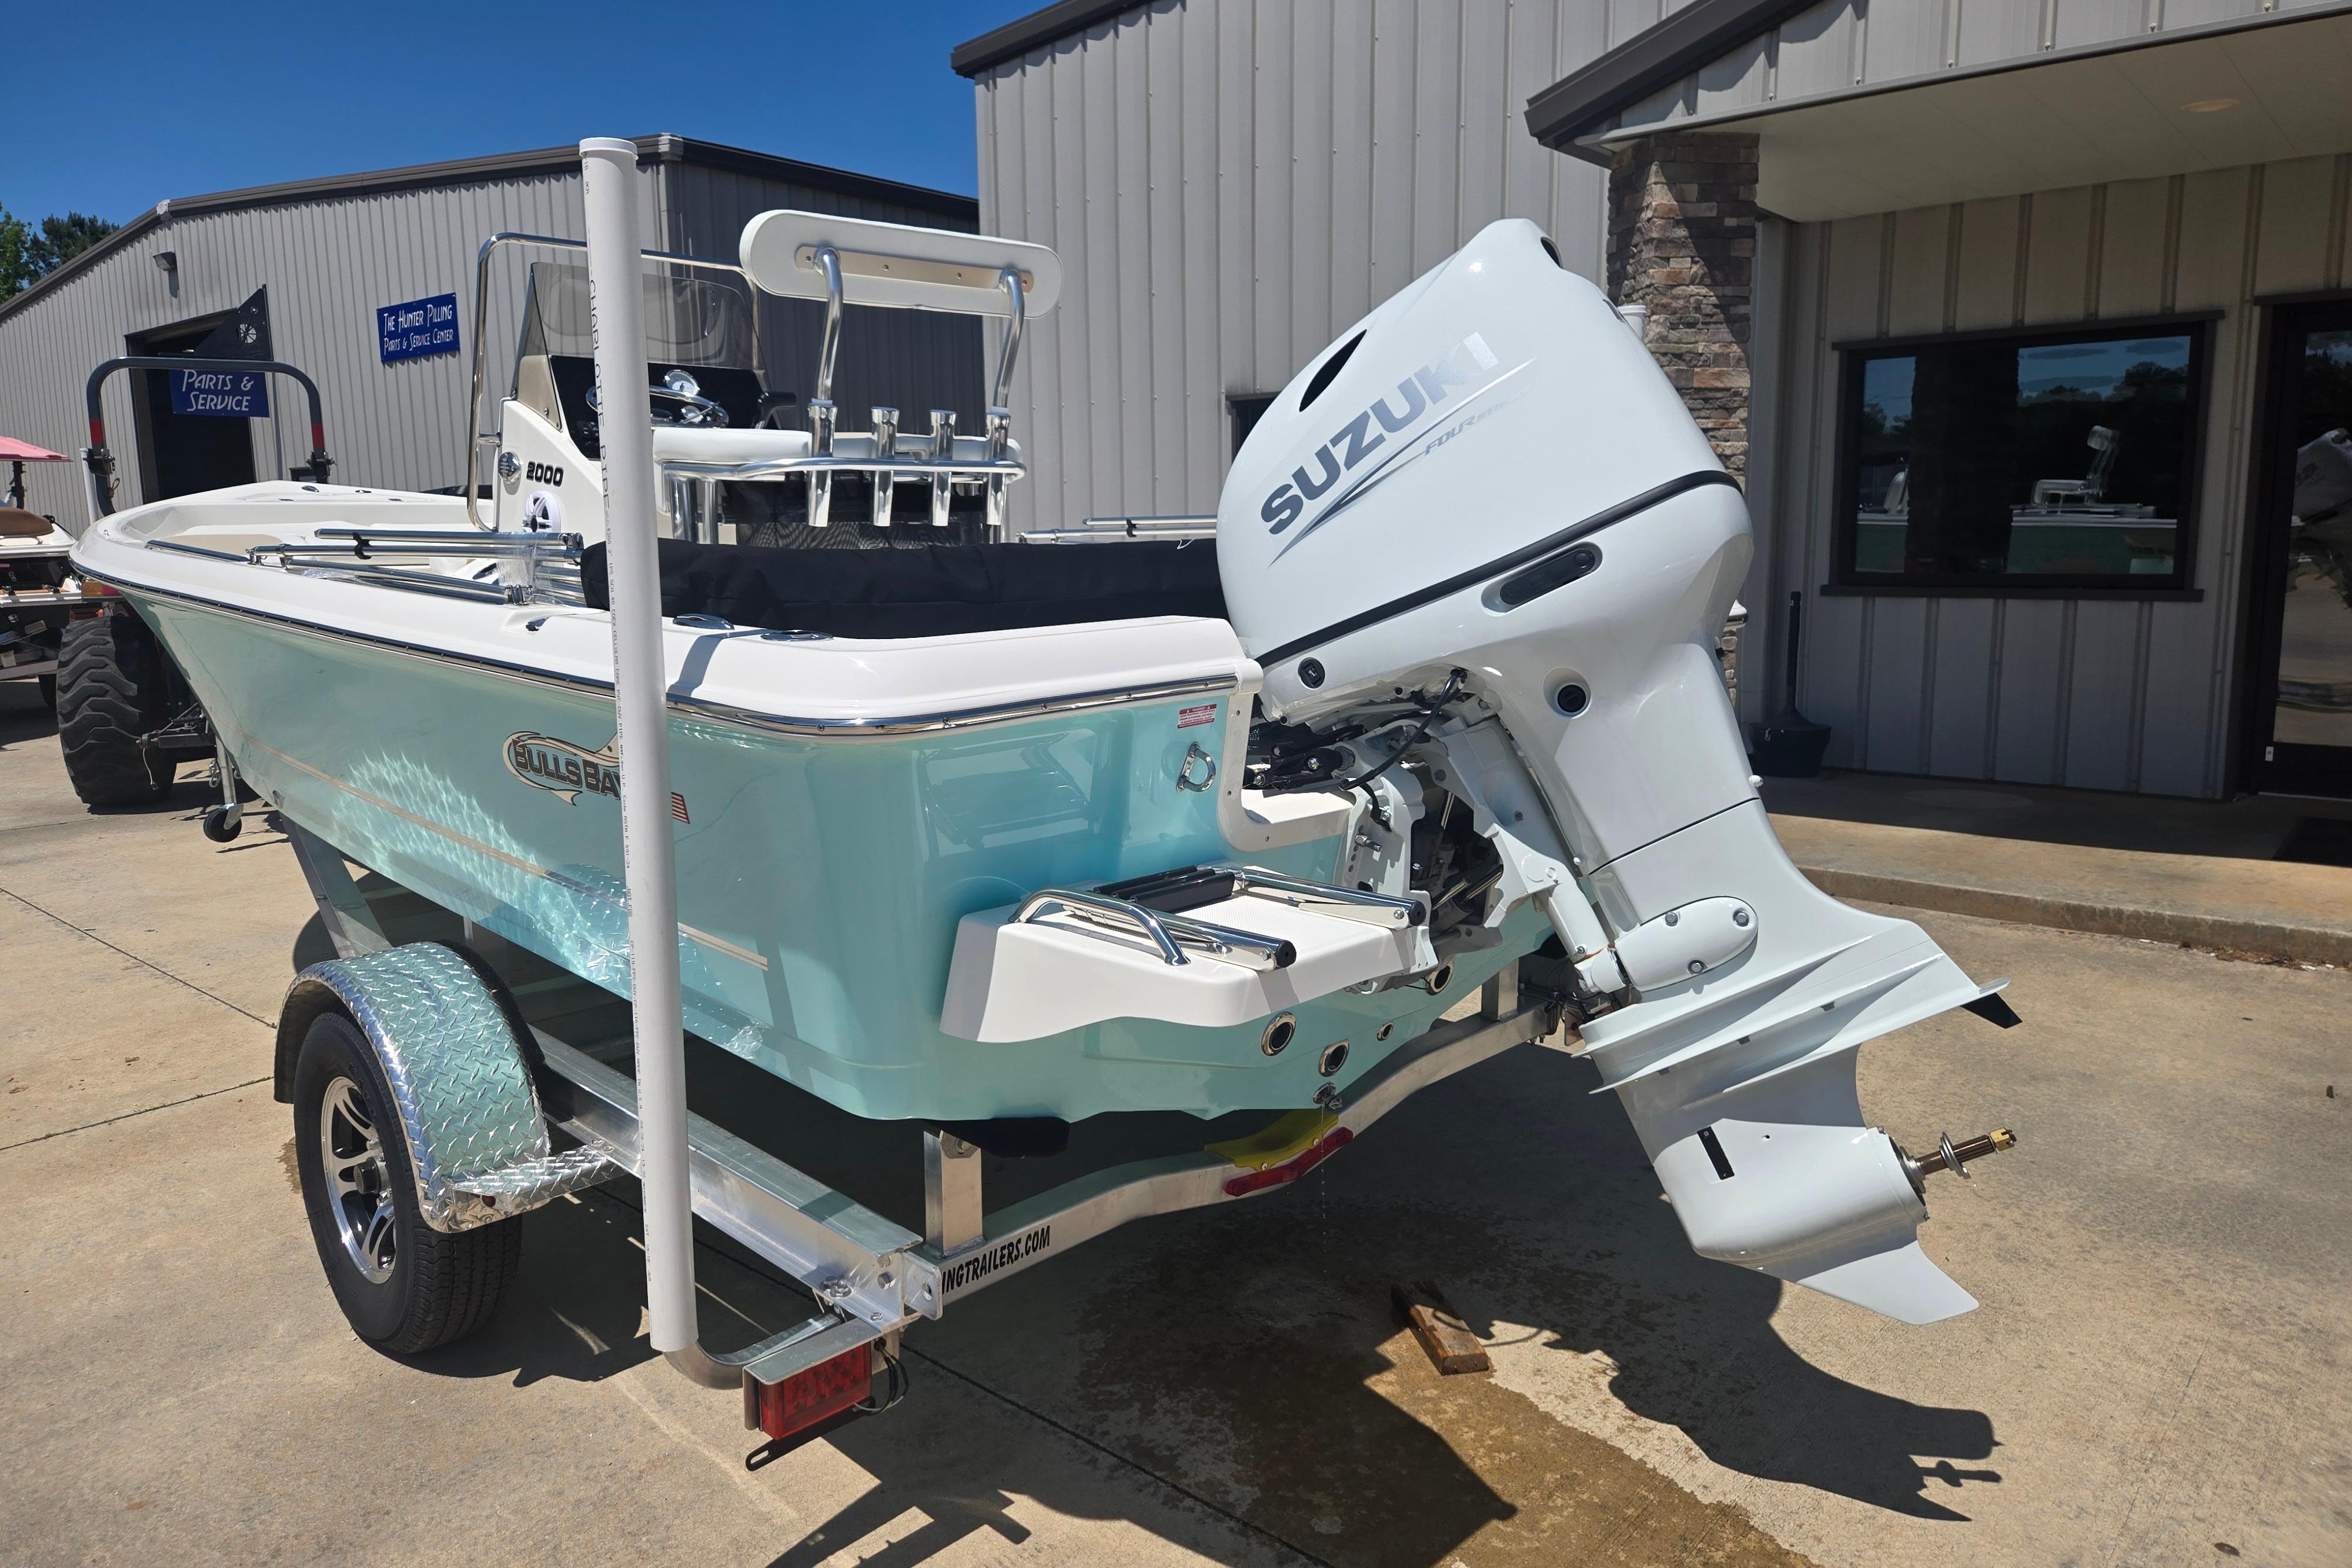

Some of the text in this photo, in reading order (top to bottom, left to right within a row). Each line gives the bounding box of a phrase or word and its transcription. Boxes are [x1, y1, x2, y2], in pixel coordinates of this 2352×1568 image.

[398, 309, 424, 333] HUNTER
[427, 304, 453, 327] PILLING
[383, 328, 454, 355] PARTS & SERVICE CENTER
[182, 369, 254, 392] PARTS &
[187, 391, 251, 412] SERVICE
[1261, 332, 1500, 534] SUZUKI
[526, 460, 564, 487] 2000
[512, 738, 582, 788] BULLS
